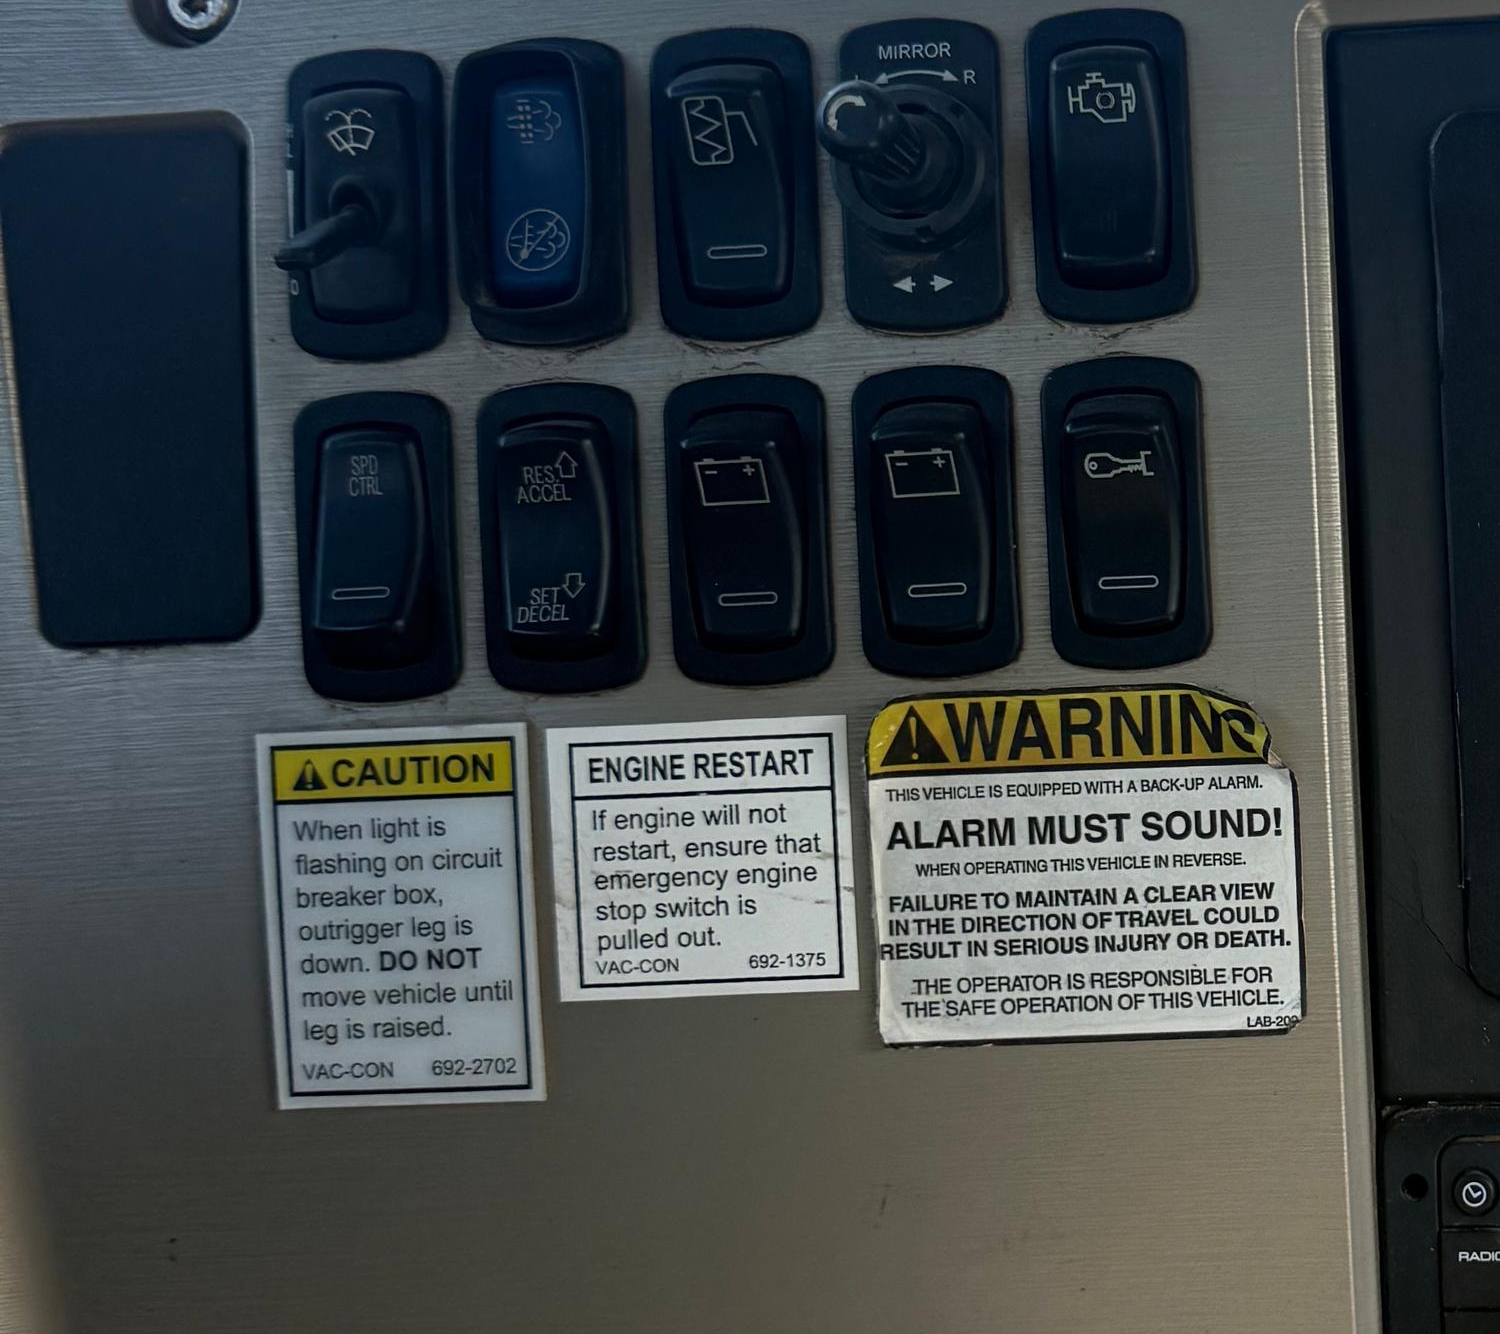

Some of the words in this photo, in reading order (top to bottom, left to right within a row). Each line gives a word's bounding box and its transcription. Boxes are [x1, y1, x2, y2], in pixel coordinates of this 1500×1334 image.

[878, 42, 951, 60] MIRROR
[963, 69, 976, 85] R
[351, 455, 378, 475] SPD
[523, 466, 560, 484] RES.
[349, 476, 384, 496] CTRL
[517, 483, 572, 505] ACCEL
[531, 587, 561, 605] SET
[517, 604, 570, 624] DECEL
[332, 753, 495, 787] CAUTION
[588, 754, 687, 784] ENGINE
[693, 749, 813, 780] RESTART
[886, 788, 920, 803] THIS
[922, 785, 986, 801] VEHICLE
[989, 784, 1003, 798] IS
[1006, 781, 1082, 798] EQUIPPED
[1085, 780, 1123, 795] WITH
[1126, 779, 1138, 793] A
[1140, 777, 1205, 793] BACK-UP
[1208, 775, 1263, 791] ALARM.
[293, 819, 363, 842] When
[370, 817, 420, 844] light
[428, 816, 446, 837] is
[592, 809, 607, 831] If
[613, 807, 696, 833] engine
[702, 805, 740, 826] will
[748, 803, 787, 824] not
[887, 817, 1016, 850] ALARM
[1029, 813, 1131, 845] MUST
[1142, 808, 1282, 841] SOUND!
[593, 840, 677, 864] restart,
[684, 838, 768, 859] ensure
[776, 833, 822, 855] that
[295, 854, 386, 879] flashing
[395, 854, 423, 871] on
[432, 848, 503, 869] circuit
[594, 867, 728, 892] emergency
[737, 862, 818, 888] engine
[916, 863, 961, 877] WHEN
[963, 858, 1049, 875] OPERATING
[1050, 857, 1087, 872] THIS
[1089, 855, 1152, 871] VEHICLE
[1155, 854, 1169, 868] IN
[1172, 852, 1247, 868] REVERSE.
[297, 886, 385, 909] breaker
[393, 884, 444, 907] box,
[596, 901, 648, 925] stop
[654, 896, 730, 919] switch
[738, 896, 757, 916] is
[889, 893, 978, 913] FAILURE
[981, 892, 1011, 909] TO
[1016, 888, 1118, 908] MAINTAIN
[1123, 887, 1140, 904] A
[1143, 884, 1216, 904] CLEAR
[1221, 881, 1276, 901] VIEW
[299, 919, 403, 944] outrigger
[411, 917, 445, 941] leg
[455, 916, 473, 936] is
[889, 918, 911, 937] IN
[914, 917, 955, 935] THE
[961, 913, 1076, 933] DIRECTION
[1082, 912, 1112, 930] OF
[1115, 909, 1199, 929] TRAVEL
[1204, 905, 1280, 926] COULD
[598, 928, 668, 954] pulled
[677, 927, 722, 947] out.
[881, 941, 963, 961] RESULT
[967, 940, 988, 958] IN
[994, 936, 1089, 957] SERIOUS
[1094, 933, 1171, 953] INJURY
[1177, 932, 1209, 951] OR
[1215, 929, 1291, 949] DEATH.
[301, 952, 371, 974] down.
[379, 949, 418, 972] DO
[427, 948, 482, 970] NOT
[595, 957, 680, 976] VAC-CON
[748, 952, 827, 969] 692-1375
[302, 989, 366, 1008] move
[373, 983, 457, 1005] vehicle
[465, 979, 515, 1002] until
[913, 979, 953, 995] THE
[957, 974, 1061, 994] OPERATOR
[1066, 974, 1086, 990] IS
[1091, 969, 1227, 989] RESPONSIBLE
[1232, 967, 1273, 984] FOR
[901, 1002, 941, 1019] THE
[946, 998, 997, 1017] SAFE
[1001, 995, 1113, 1015] OPERATION
[1118, 994, 1145, 1010] OF
[1149, 992, 1193, 1009] THIS
[1196, 988, 1285, 1008] VEHICLE.
[304, 1020, 338, 1044] leg
[346, 1020, 365, 1040] is
[372, 1015, 453, 1039] raised.
[302, 1061, 394, 1080] VAC-CON
[431, 1057, 517, 1077] 692-2702
